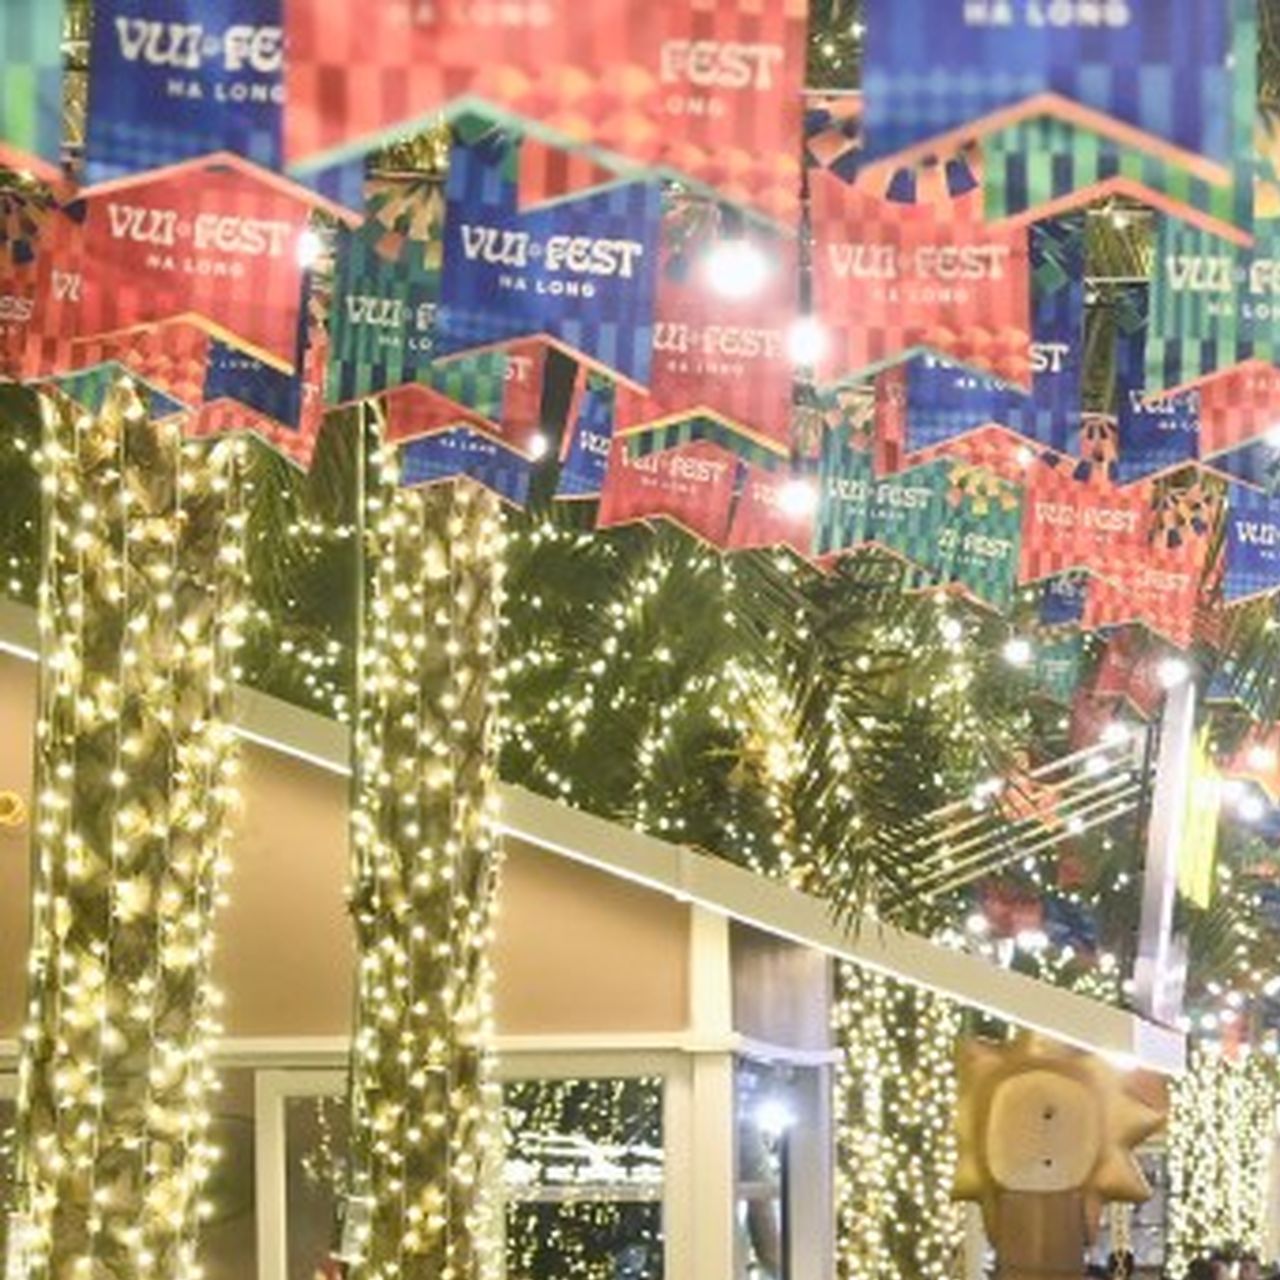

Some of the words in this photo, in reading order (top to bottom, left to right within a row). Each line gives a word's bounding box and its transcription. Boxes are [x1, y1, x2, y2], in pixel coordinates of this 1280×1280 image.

[1025, 0, 1130, 28] LONG
[116, 17, 201, 69] VUI
[224, 26, 284, 72] FE
[660, 41, 784, 91] FEST
[167, 80, 202, 98] HA
[215, 84, 287, 103] LONG
[667, 97, 724, 117] ONG
[108, 204, 178, 245] VUI
[193, 213, 292, 256] FEST
[461, 225, 529, 265] VUI
[545, 236, 642, 278] FEST
[828, 244, 896, 278] VUI
[915, 246, 1010, 280] FEST
[146, 255, 174, 271] HA
[183, 258, 244, 278] LONG
[1166, 256, 1233, 293] VUI
[500, 277, 526, 291] HA
[536, 280, 595, 298] LONG
[346, 295, 404, 327] VUI
[409, 338, 433, 350] LO
[653, 323, 687, 351] UI
[1029, 344, 1068, 371] ST
[669, 457, 728, 483] FEST
[876, 485, 932, 509] FEST
[1083, 504, 1140, 533] FEST
[1235, 521, 1275, 546] VUI
